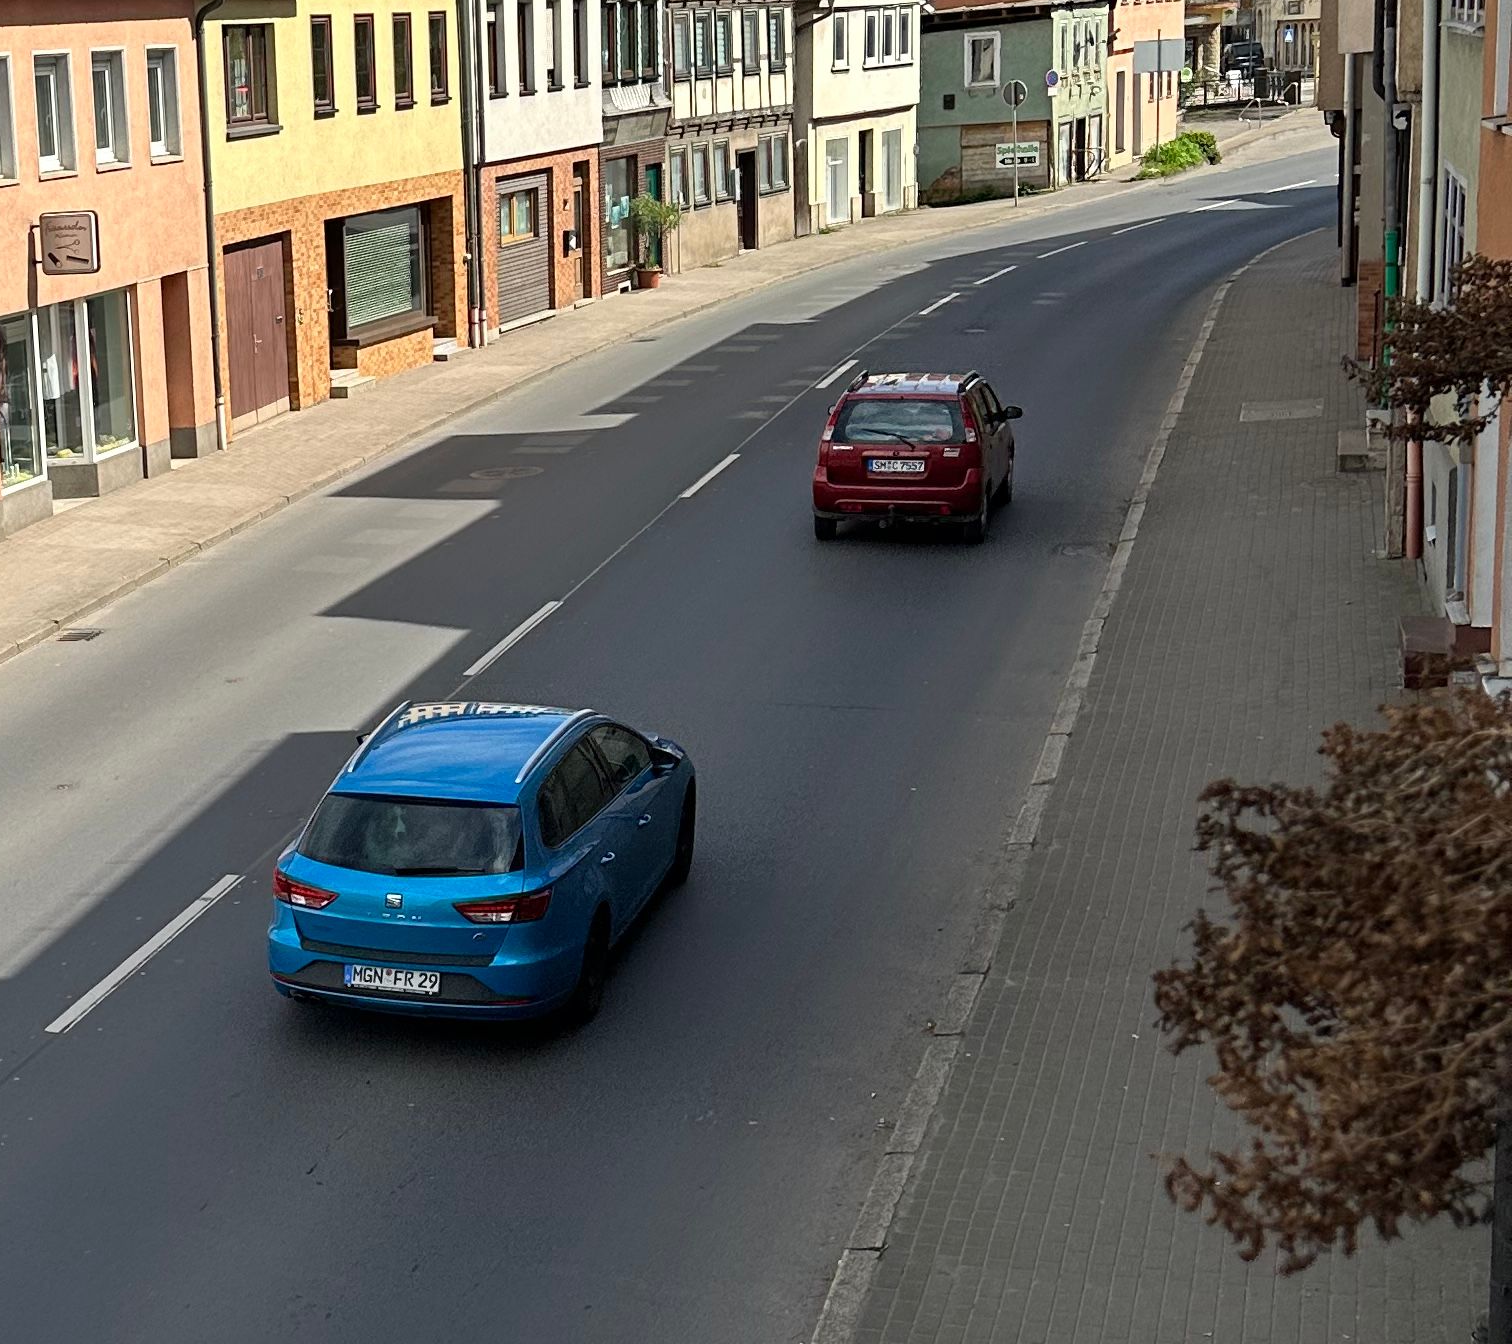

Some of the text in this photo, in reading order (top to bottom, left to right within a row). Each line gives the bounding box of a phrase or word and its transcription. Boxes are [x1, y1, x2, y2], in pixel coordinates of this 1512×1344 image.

[900, 461, 924, 470] 7557
[352, 966, 438, 990] MGN FR 29
